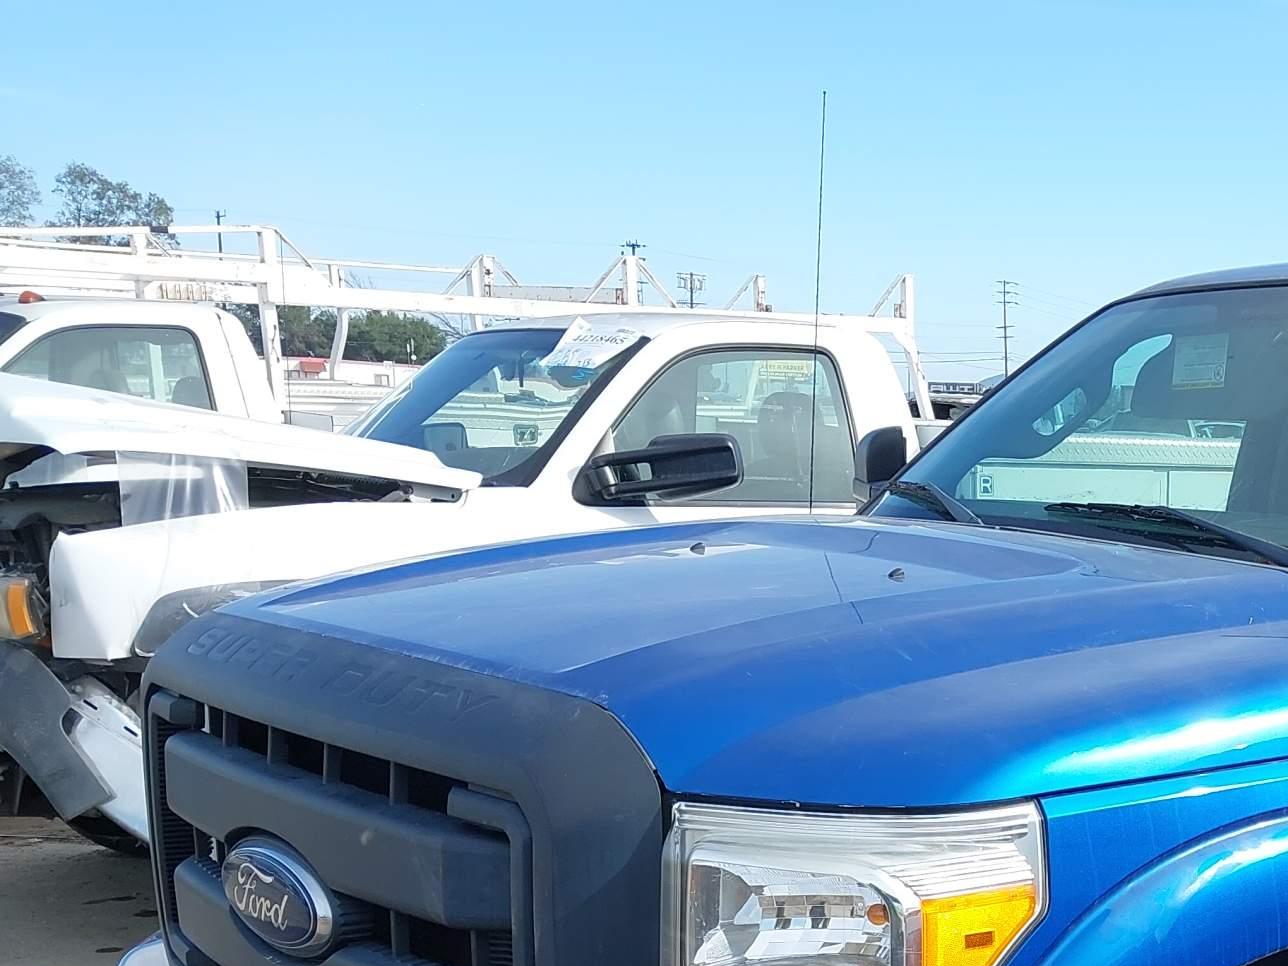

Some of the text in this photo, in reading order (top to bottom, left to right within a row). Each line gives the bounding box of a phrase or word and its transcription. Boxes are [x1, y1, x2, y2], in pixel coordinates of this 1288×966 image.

[186, 627, 502, 722] SUPER DUTY
[234, 863, 288, 931] Ford
